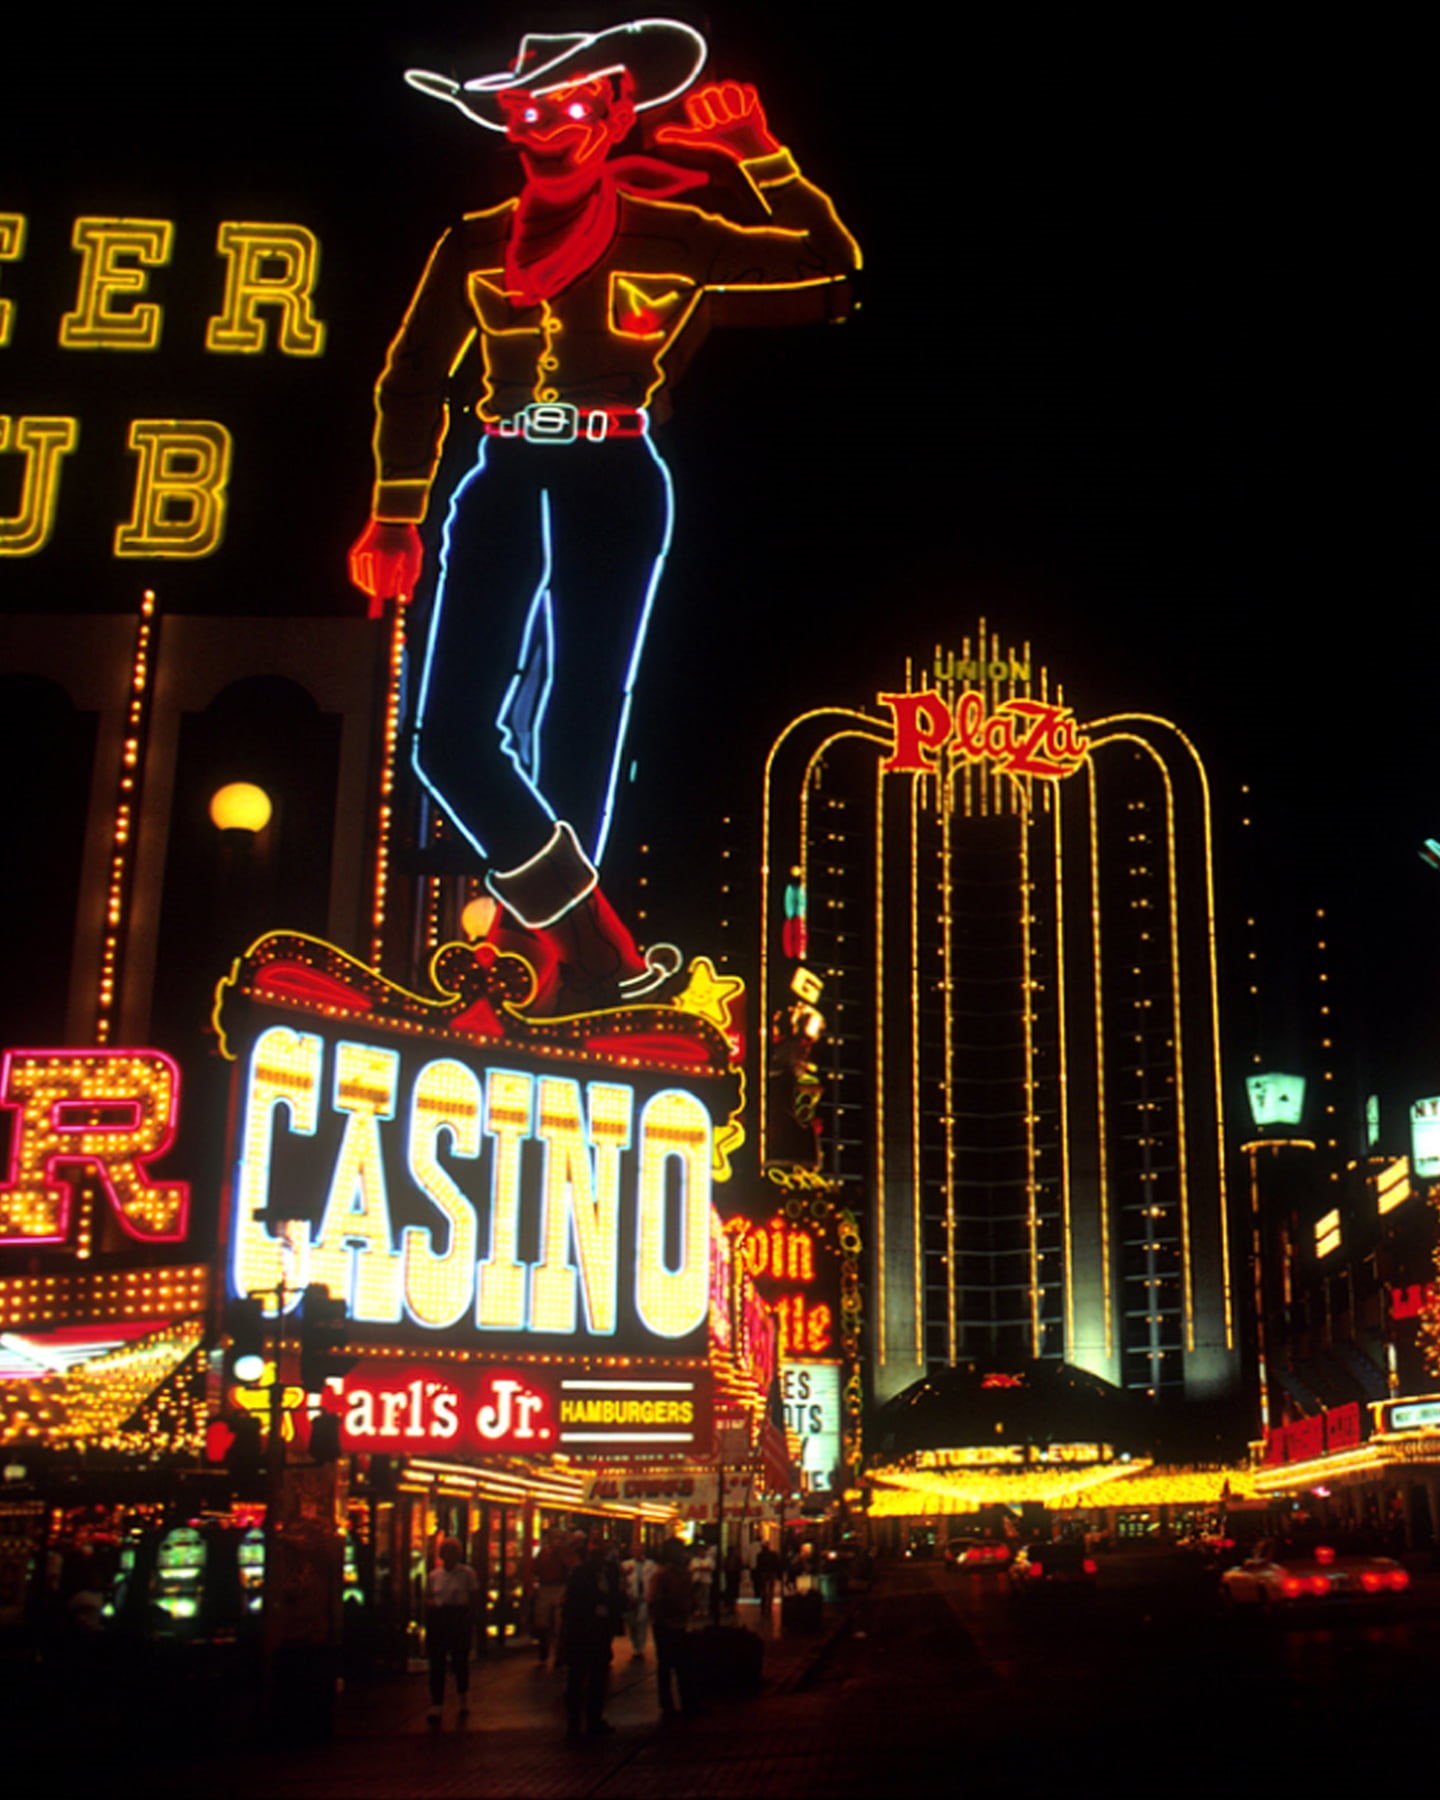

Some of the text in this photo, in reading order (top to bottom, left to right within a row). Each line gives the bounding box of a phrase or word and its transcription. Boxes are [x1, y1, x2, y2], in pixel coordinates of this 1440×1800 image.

[0, 213, 326, 357] ER
[934, 661, 1031, 682] UNION
[877, 690, 1089, 779] Plaza
[0, 1049, 190, 1243] R
[233, 1025, 712, 1338] CASINO
[722, 1214, 814, 1281] oin
[476, 1379, 550, 1438] Jr.
[561, 1400, 694, 1424] HAMBURGERS
